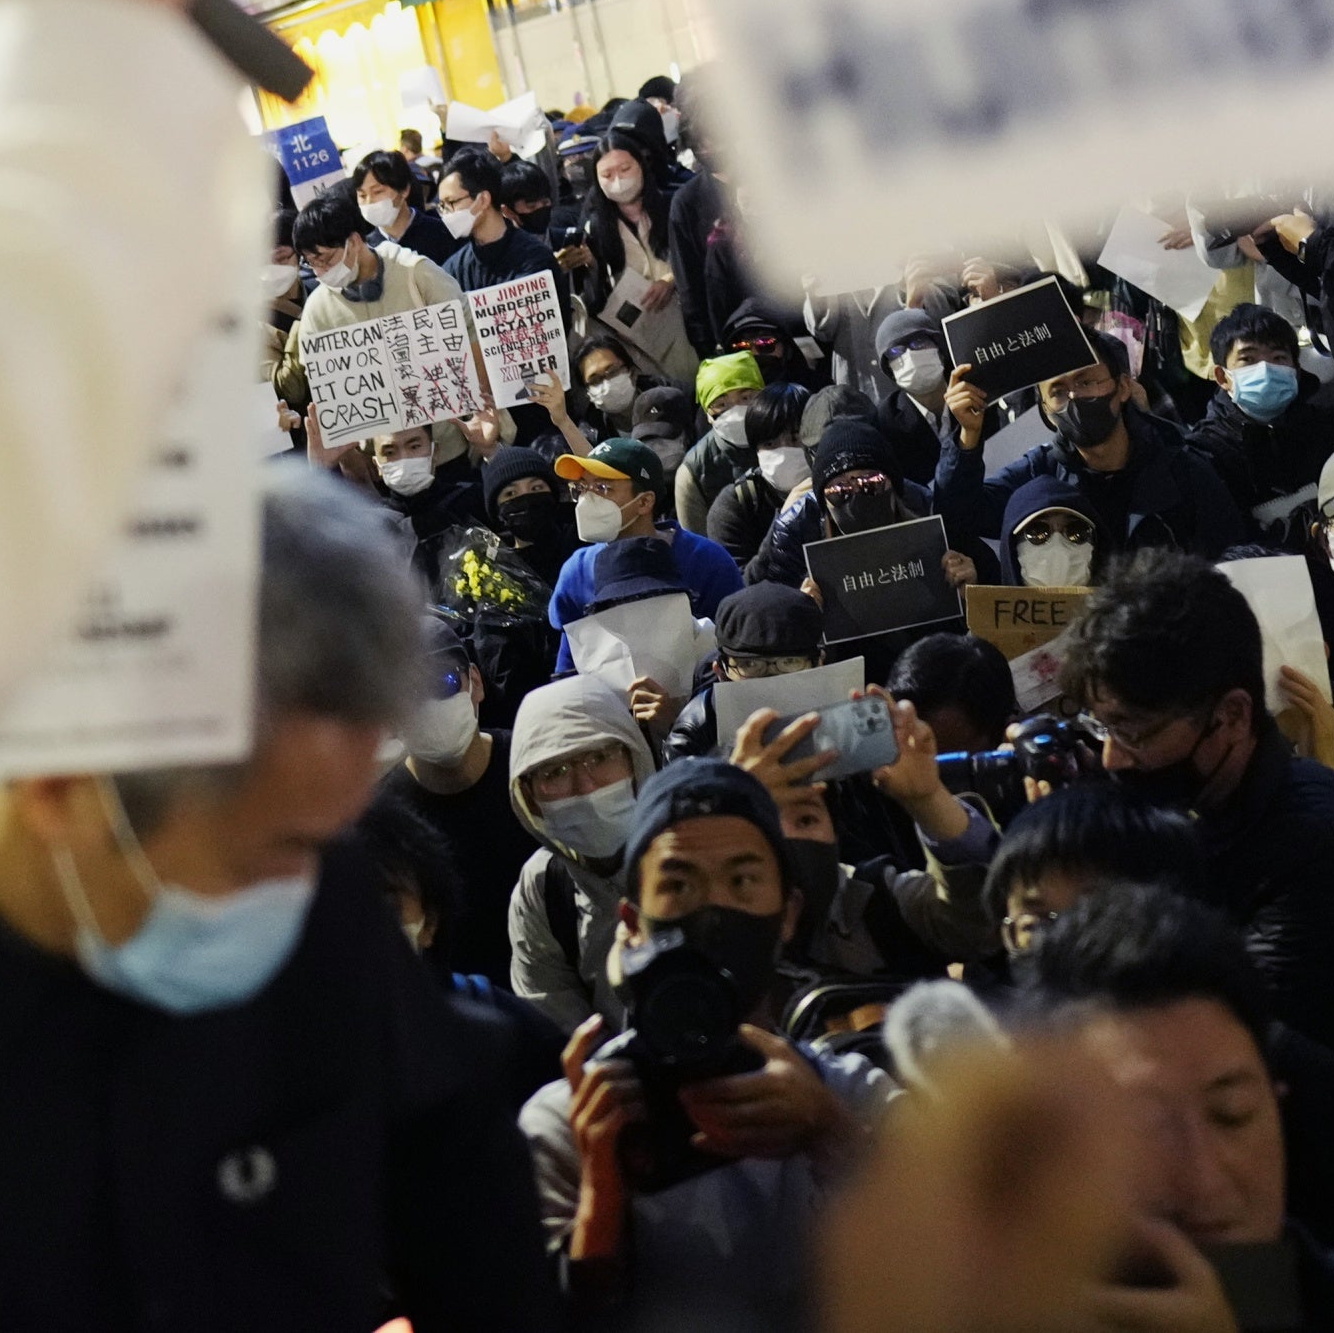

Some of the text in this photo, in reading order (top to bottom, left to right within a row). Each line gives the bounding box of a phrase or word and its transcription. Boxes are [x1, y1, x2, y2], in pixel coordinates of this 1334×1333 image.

[290, 134, 313, 154] 北
[293, 149, 330, 172] 1126
[474, 277, 547, 307] XI JINPING
[475, 290, 551, 319] MURDERER
[301, 323, 383, 355] WATER CAN
[413, 309, 439, 355] 民主
[437, 304, 464, 352] 自由
[480, 309, 556, 338] DICTATOR
[306, 347, 383, 380] FLOW OR
[312, 370, 385, 404] IT CAN
[320, 392, 398, 430] CRASH
[994, 599, 1068, 629] FREE
